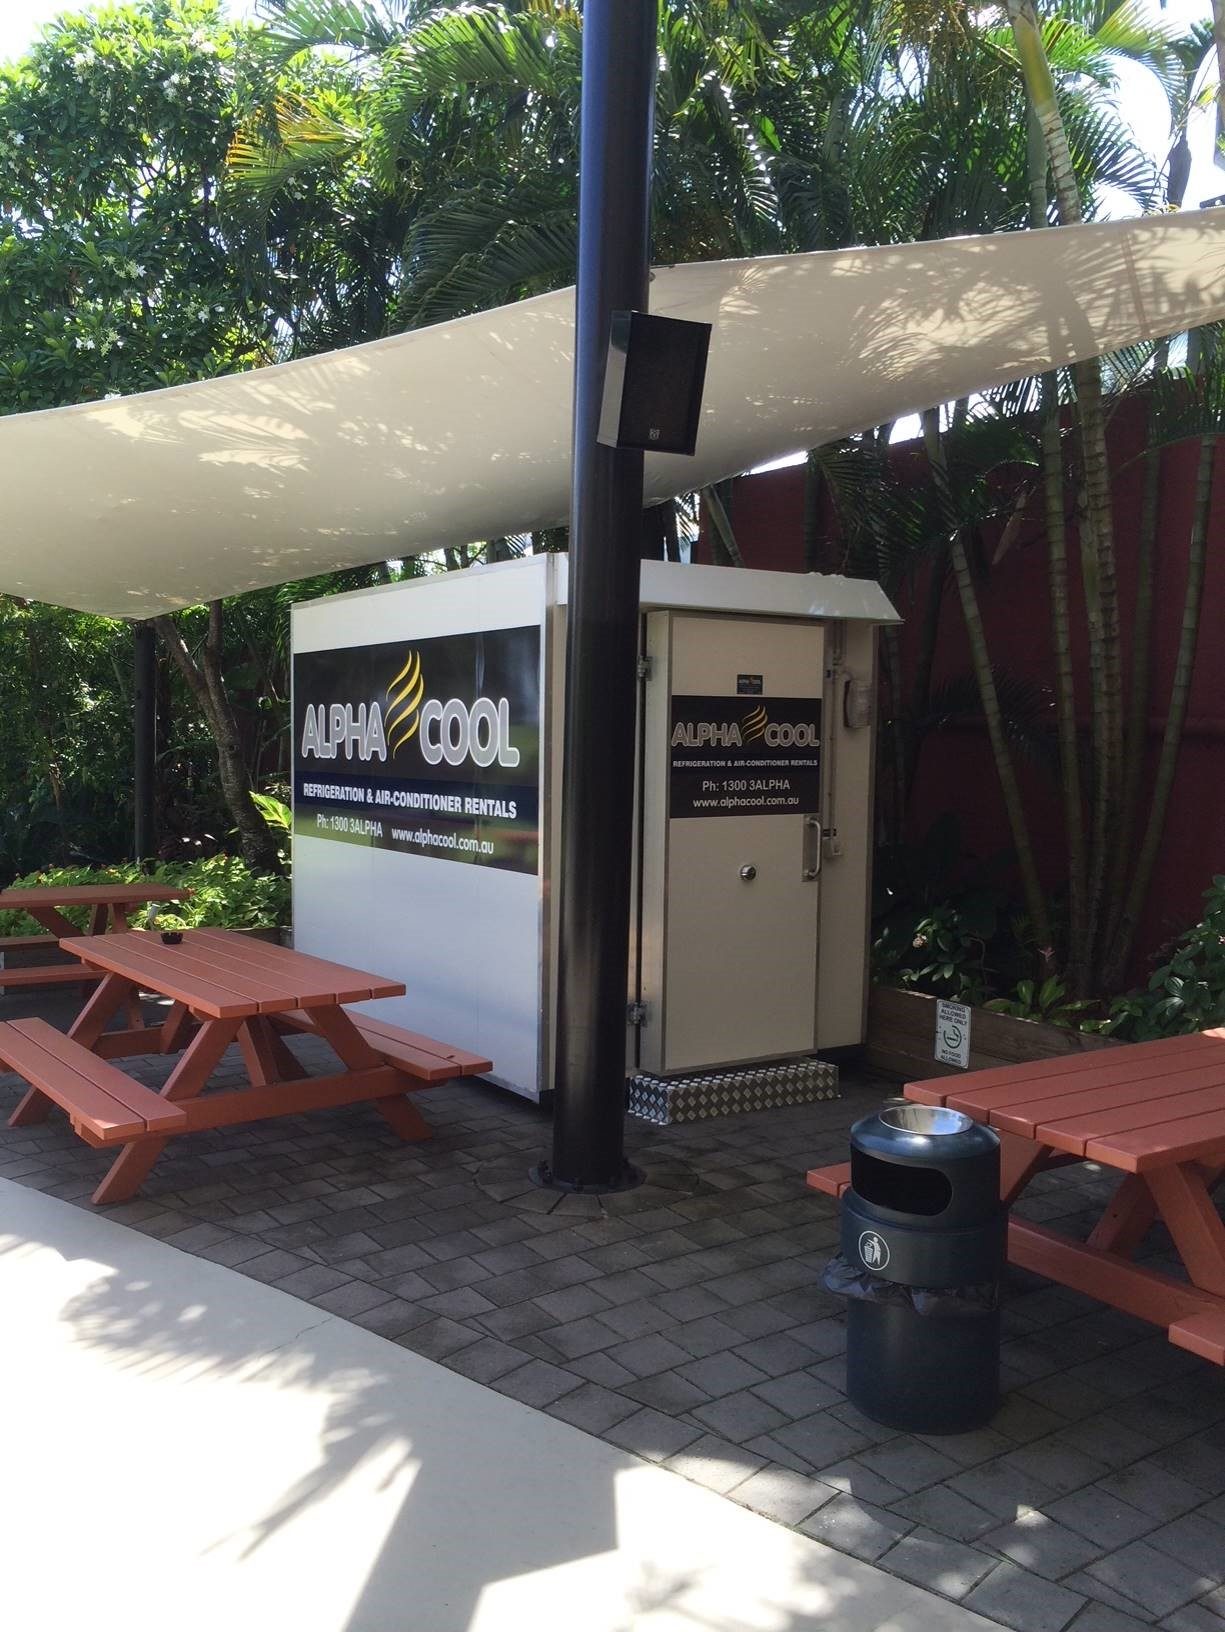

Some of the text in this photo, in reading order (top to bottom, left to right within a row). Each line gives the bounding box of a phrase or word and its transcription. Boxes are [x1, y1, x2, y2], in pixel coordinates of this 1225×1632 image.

[302, 697, 520, 767] ALPHA COOL
[671, 722, 820, 747] ALPHA COOL
[702, 779, 791, 791] Ph: 1300 3ALPHA
[303, 783, 517, 819] REFRIGERATION & AIR-CONDITIONER RENTALS
[693, 796, 799, 808] www.alphacool.com.au
[317, 814, 494, 854] Ph: 1300 3ALPHA www.alphacool.com.au
[941, 1008, 966, 1020] ALLOWED
